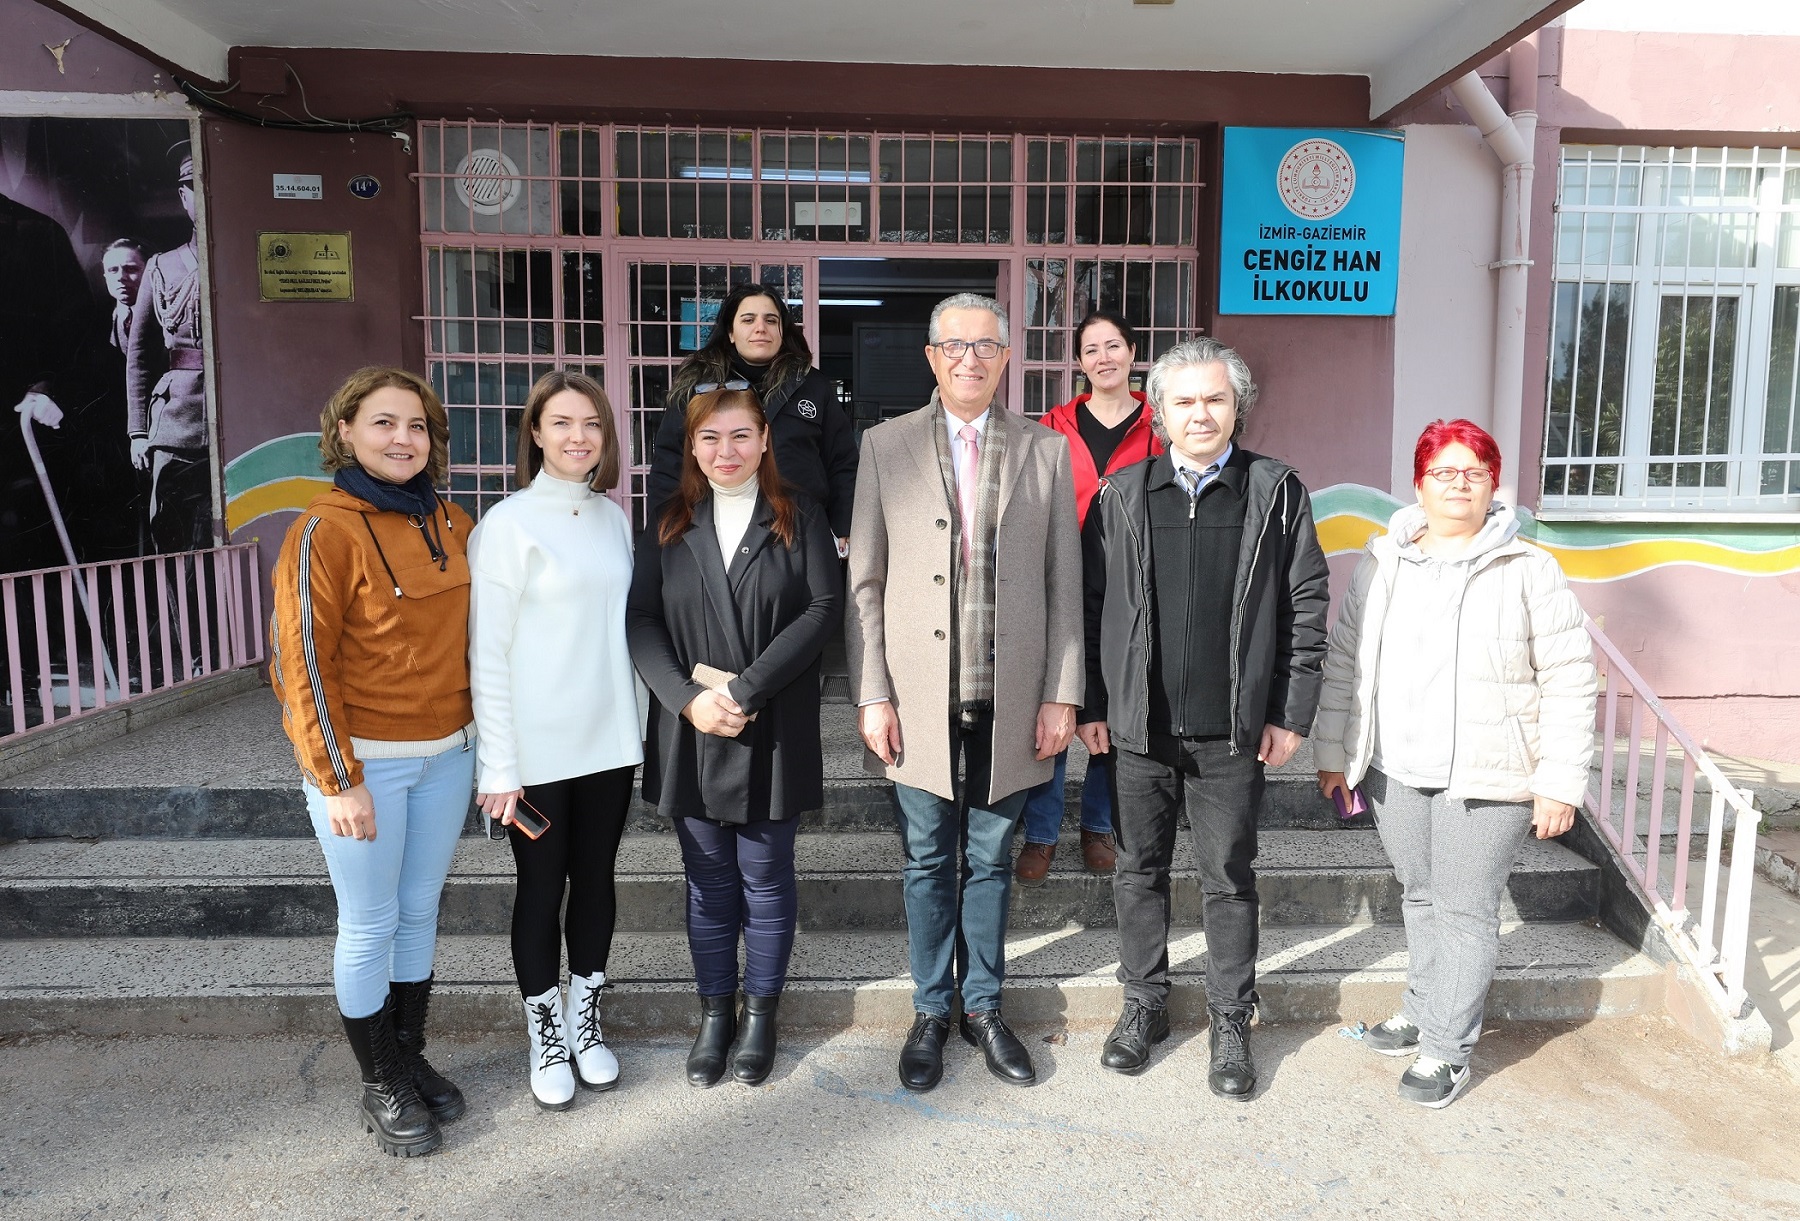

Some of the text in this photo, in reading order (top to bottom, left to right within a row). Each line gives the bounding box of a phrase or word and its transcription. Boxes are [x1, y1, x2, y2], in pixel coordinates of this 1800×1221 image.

[1259, 223, 1366, 241] İZMİR-GAZİEMİR
[1243, 244, 1381, 272] CENGİZ HAN
[1253, 274, 1369, 302] İLKOKULU
